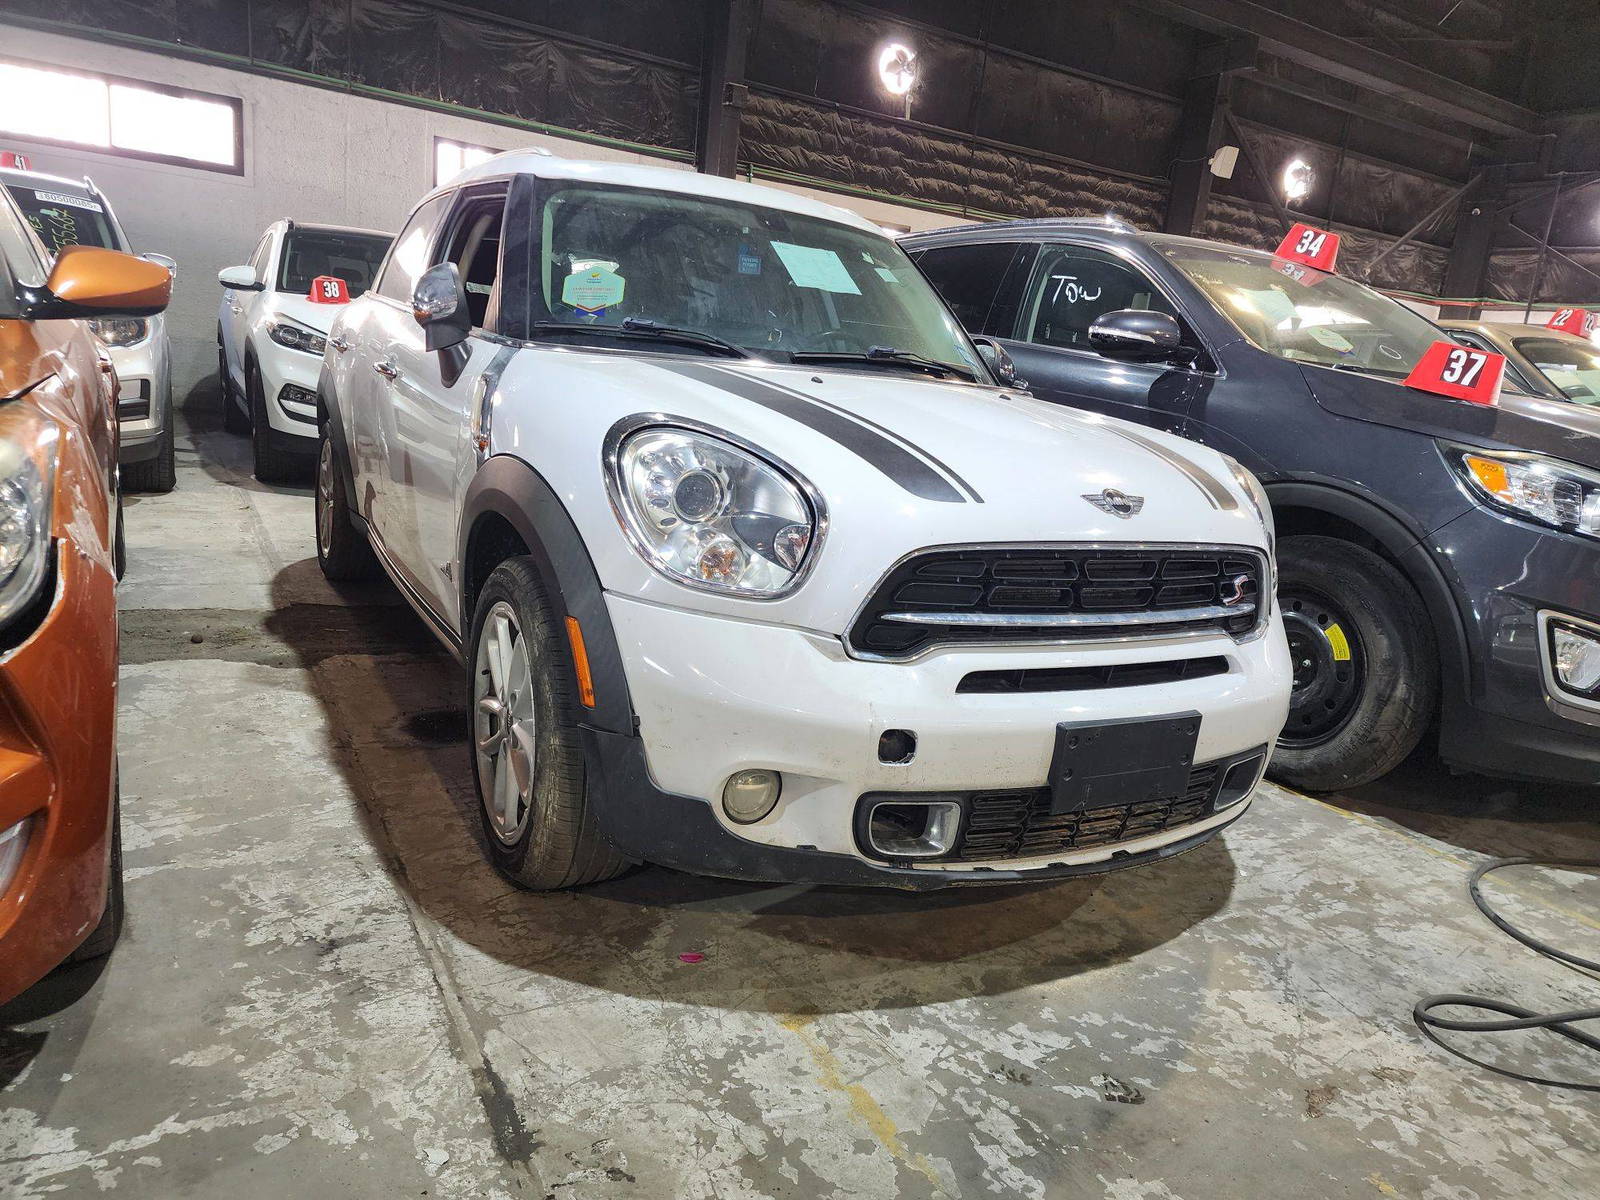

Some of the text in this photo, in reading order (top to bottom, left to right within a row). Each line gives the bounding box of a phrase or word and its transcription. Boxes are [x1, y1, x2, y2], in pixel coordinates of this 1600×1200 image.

[1295, 230, 1327, 258] 34
[323, 281, 340, 298] 38
[1551, 309, 1574, 327] 22
[1443, 349, 1487, 387] 37
